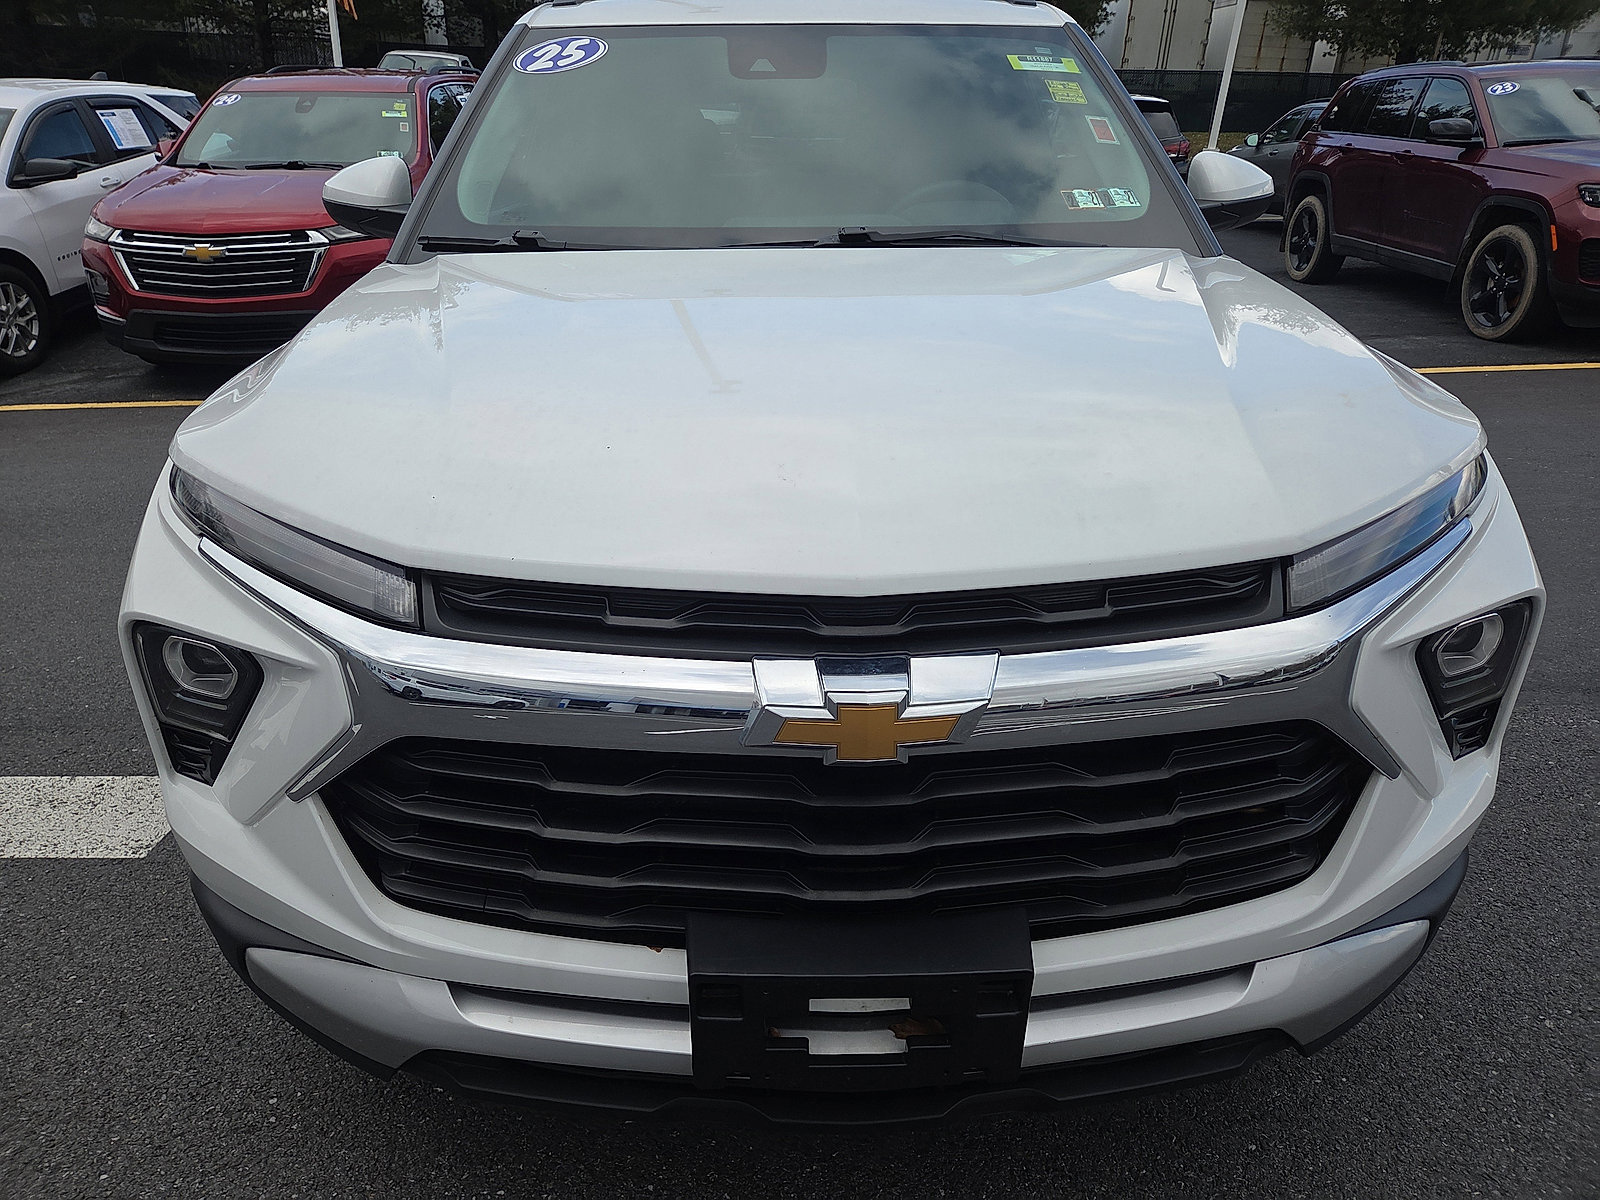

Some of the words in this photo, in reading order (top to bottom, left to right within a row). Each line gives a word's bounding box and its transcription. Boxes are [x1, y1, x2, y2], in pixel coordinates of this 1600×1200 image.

[526, 38, 591, 72] 25
[1492, 82, 1514, 95] 23
[214, 94, 239, 106] 24
